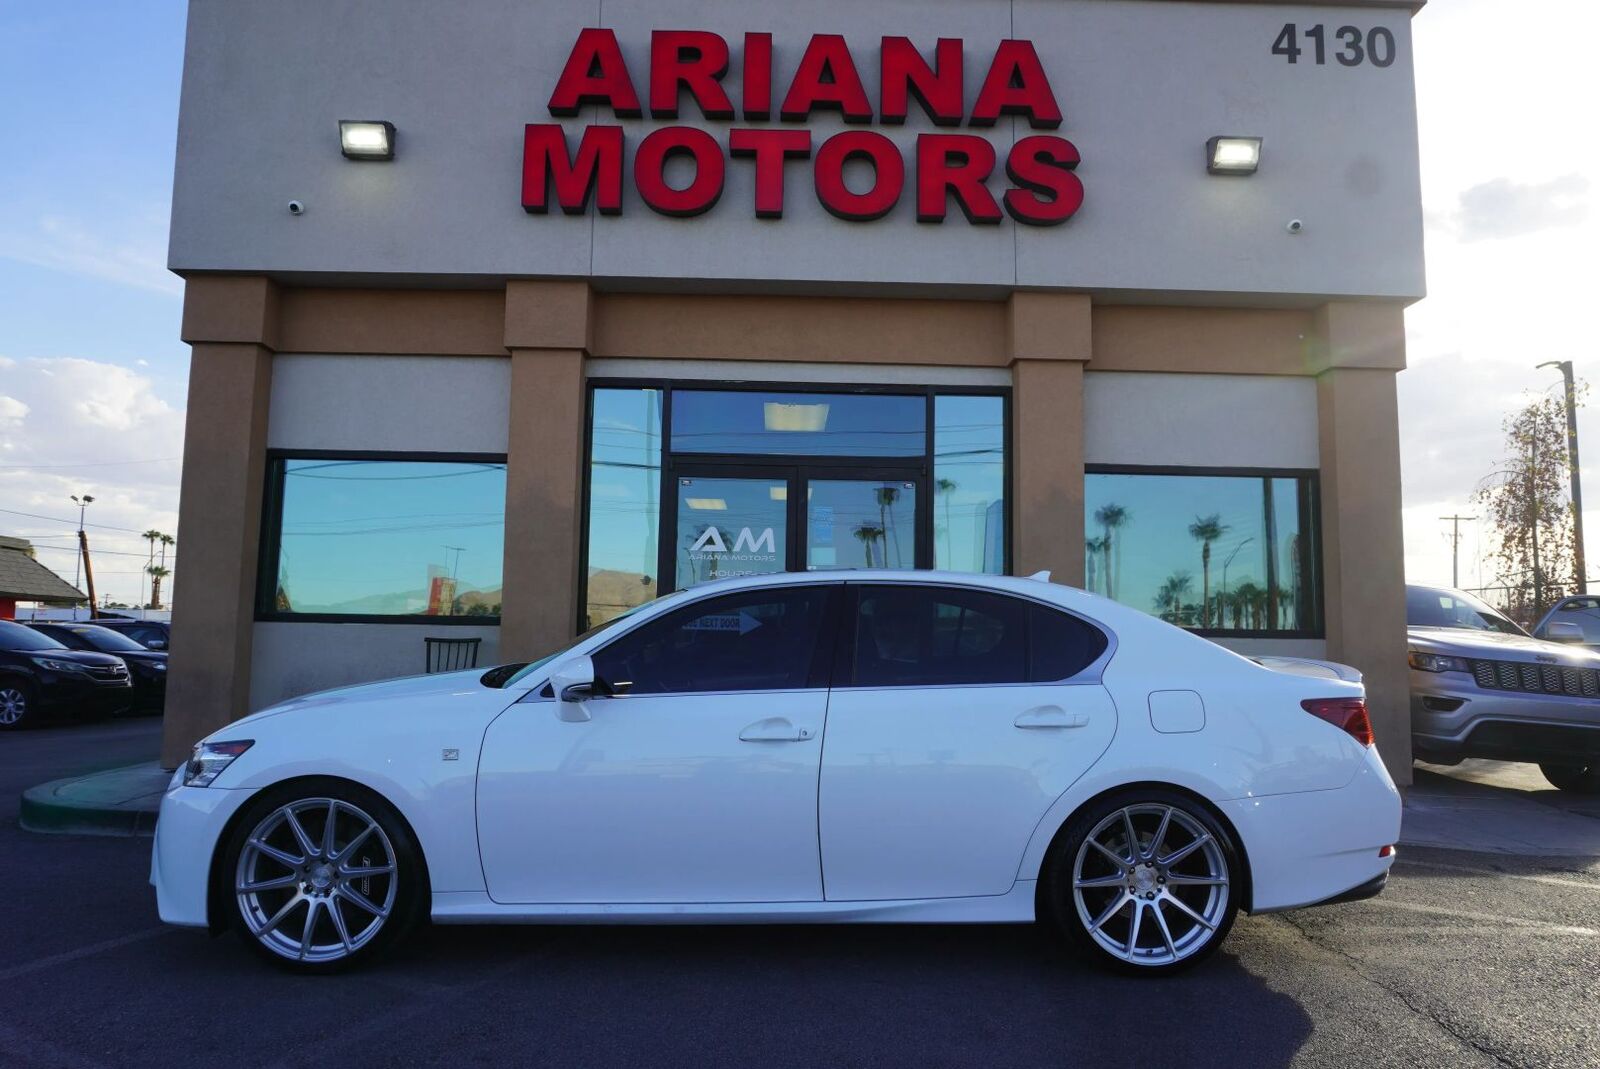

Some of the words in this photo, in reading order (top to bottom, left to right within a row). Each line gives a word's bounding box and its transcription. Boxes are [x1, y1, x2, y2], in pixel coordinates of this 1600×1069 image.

[1271, 23, 1396, 68] 4130
[547, 27, 1063, 129] ARIANA
[521, 123, 1085, 226] MOTORS
[688, 526, 776, 552] AM
[731, 554, 776, 562] MOTORS
